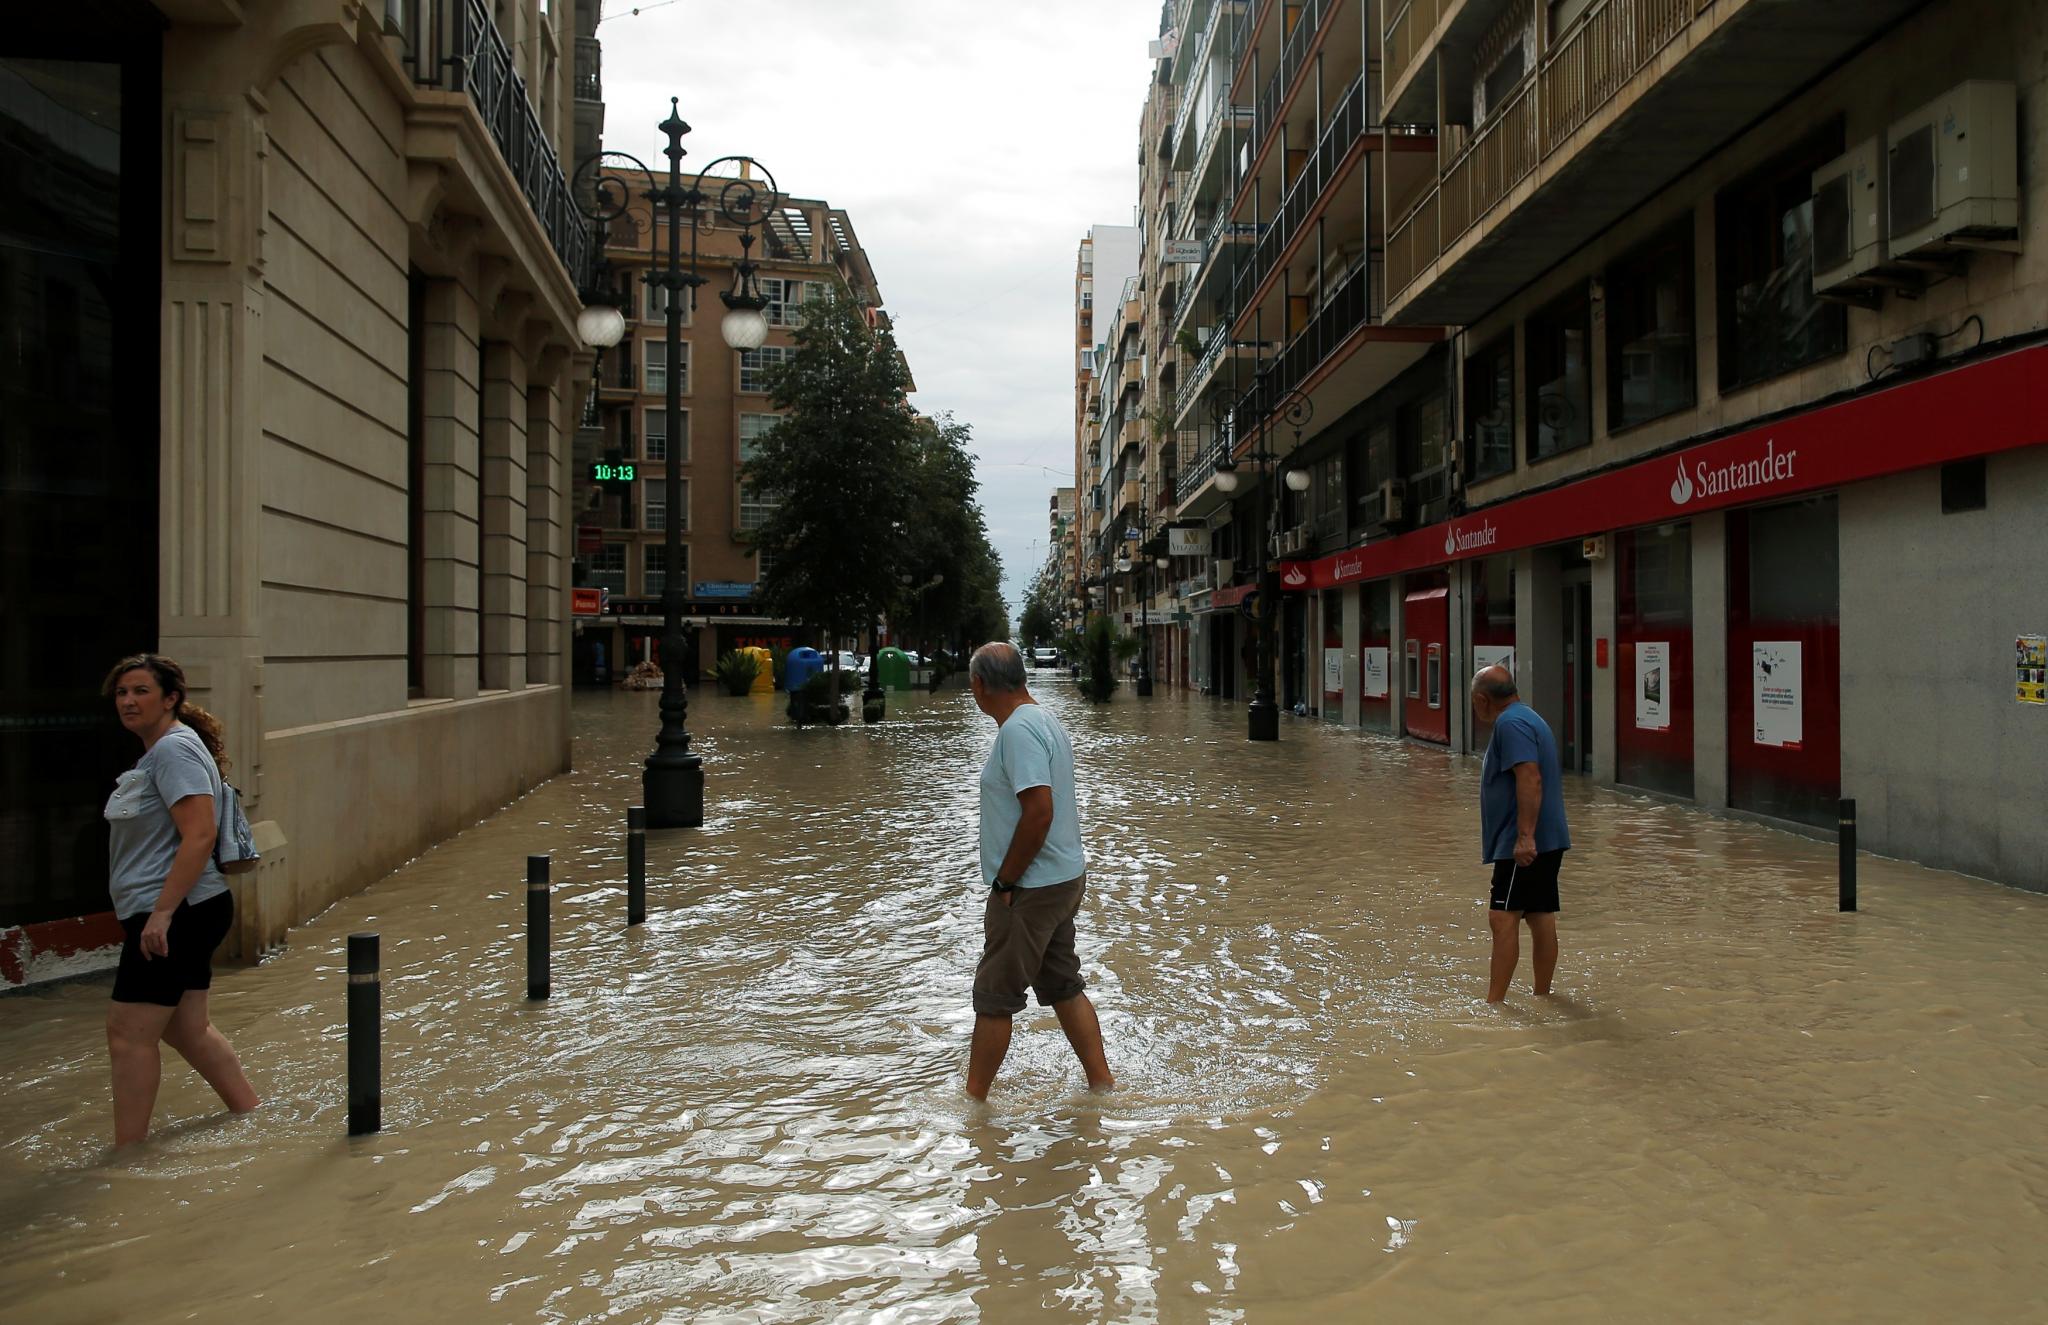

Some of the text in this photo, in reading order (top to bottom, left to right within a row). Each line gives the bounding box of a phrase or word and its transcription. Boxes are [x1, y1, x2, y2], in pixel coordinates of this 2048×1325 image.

[594, 464, 634, 481] 10:13
[1696, 438, 1797, 499] Santander
[1456, 518, 1497, 552] Santander
[1340, 554, 1362, 578] Santander
